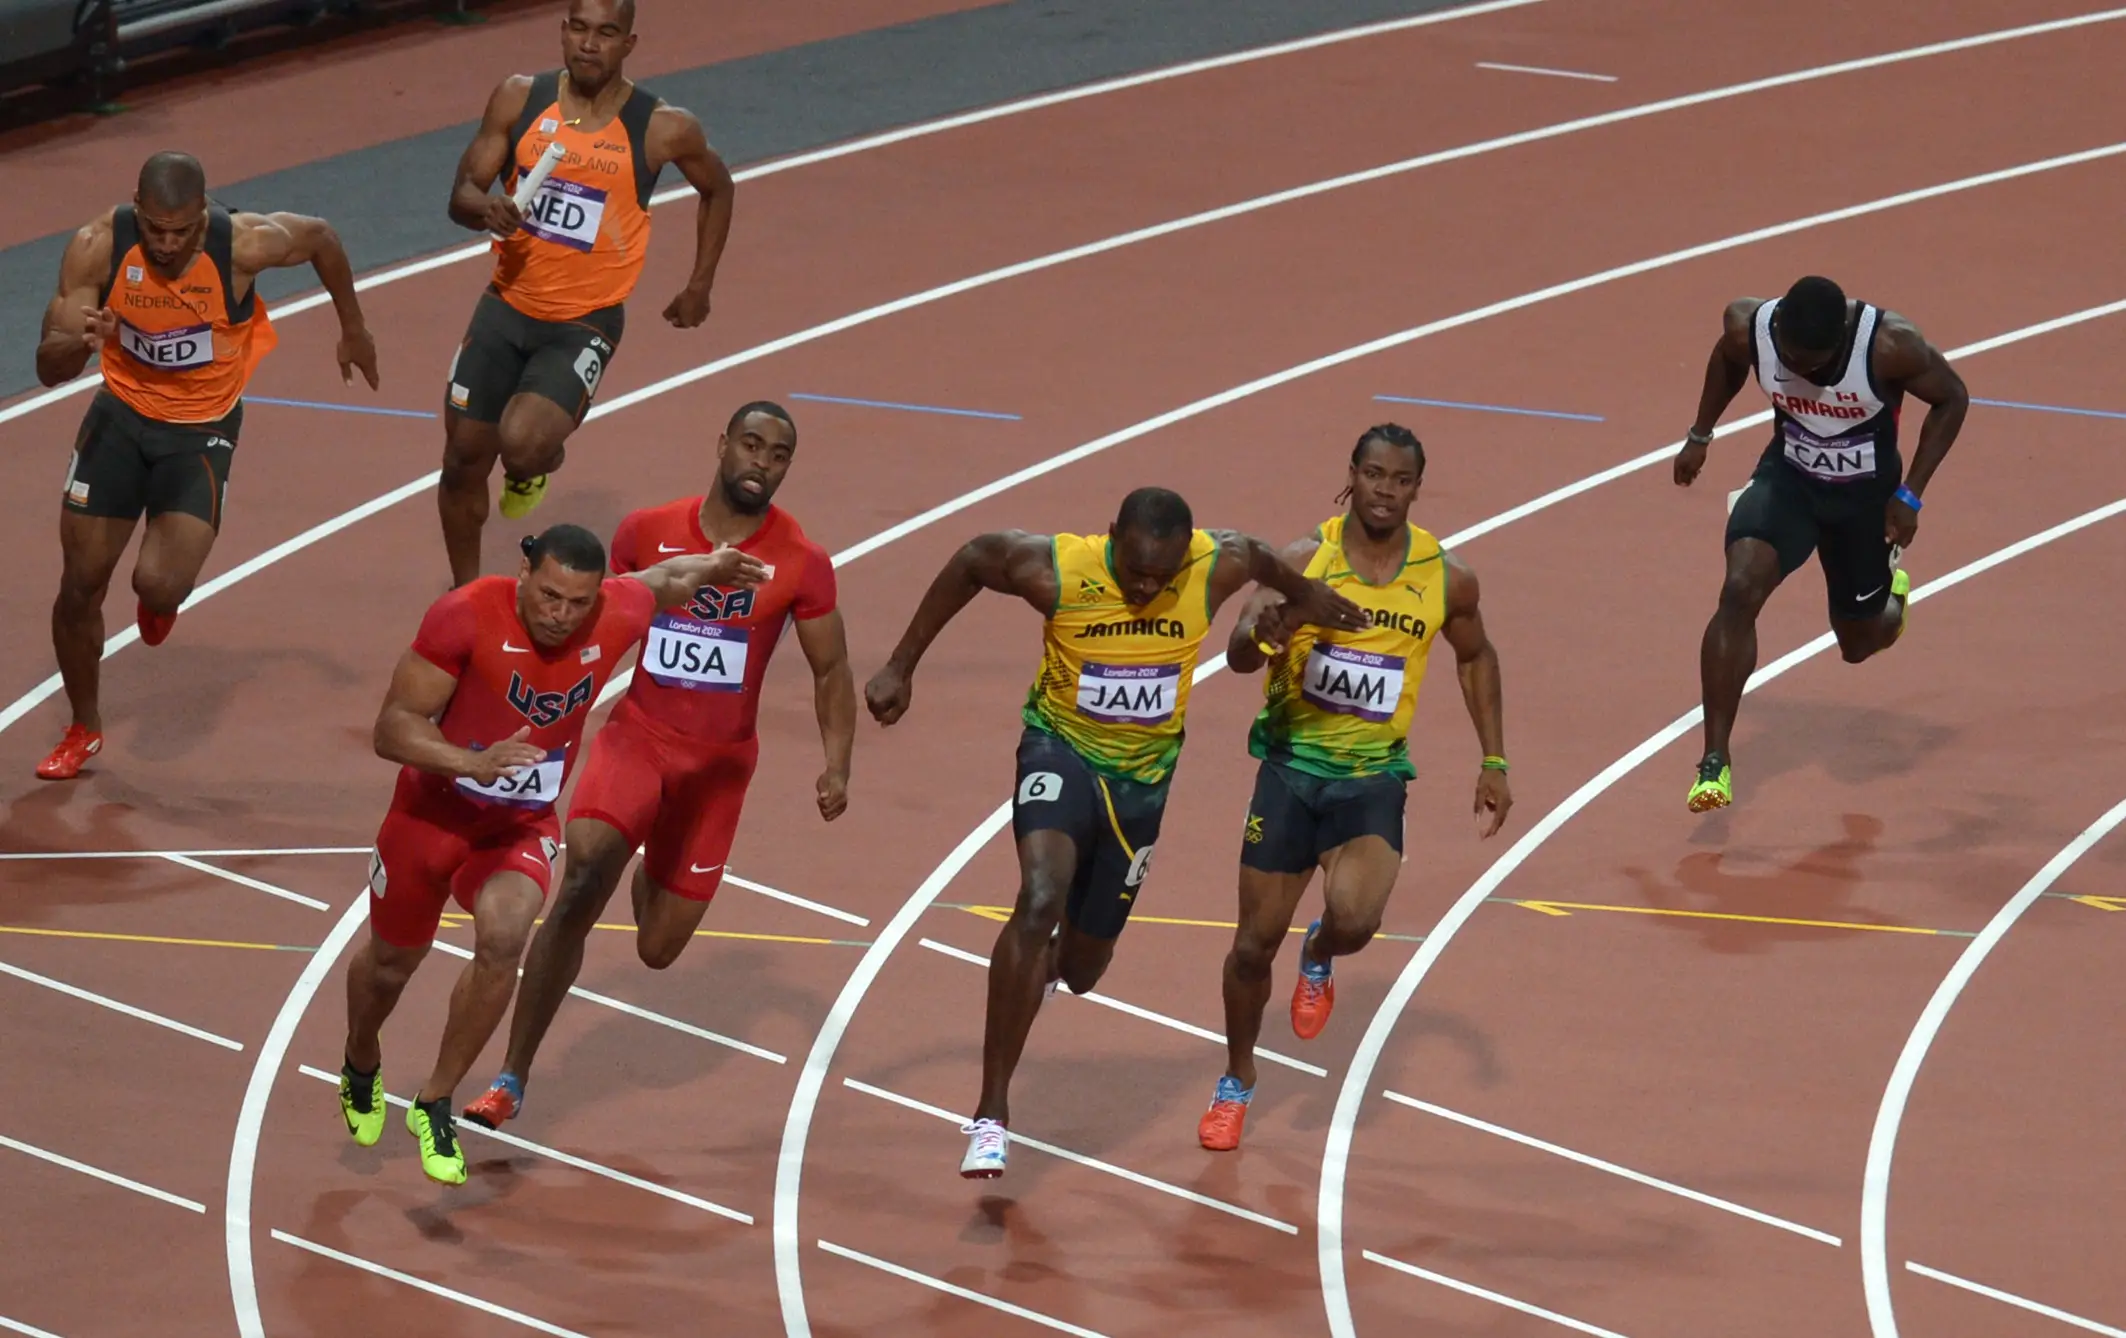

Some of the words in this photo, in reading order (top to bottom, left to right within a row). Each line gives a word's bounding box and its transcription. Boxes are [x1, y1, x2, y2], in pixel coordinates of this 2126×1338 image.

[530, 143, 619, 175] NERLAND
[531, 194, 586, 231] NED
[124, 293, 208, 315] NEDERLD
[134, 335, 197, 363] NED
[584, 360, 599, 384] 8
[1772, 392, 1867, 419] CANADA
[1794, 444, 1862, 472] CAN
[681, 585, 757, 622] SA
[668, 619, 701, 634] London
[702, 625, 723, 638] 2012
[1074, 618, 1185, 639] JAMAICA
[1363, 608, 1427, 640] AICA
[659, 637, 727, 676] USA
[1329, 648, 1361, 663] London
[1362, 653, 1384, 666] 2012
[1103, 667, 1137, 678] London
[1137, 667, 1160, 678] 2012
[1314, 665, 1386, 705] JAM
[506, 669, 594, 729] USA
[1090, 684, 1162, 712] JAM
[475, 769, 542, 794] SA
[1029, 774, 1046, 797] 6
[1136, 850, 1151, 881] 6
